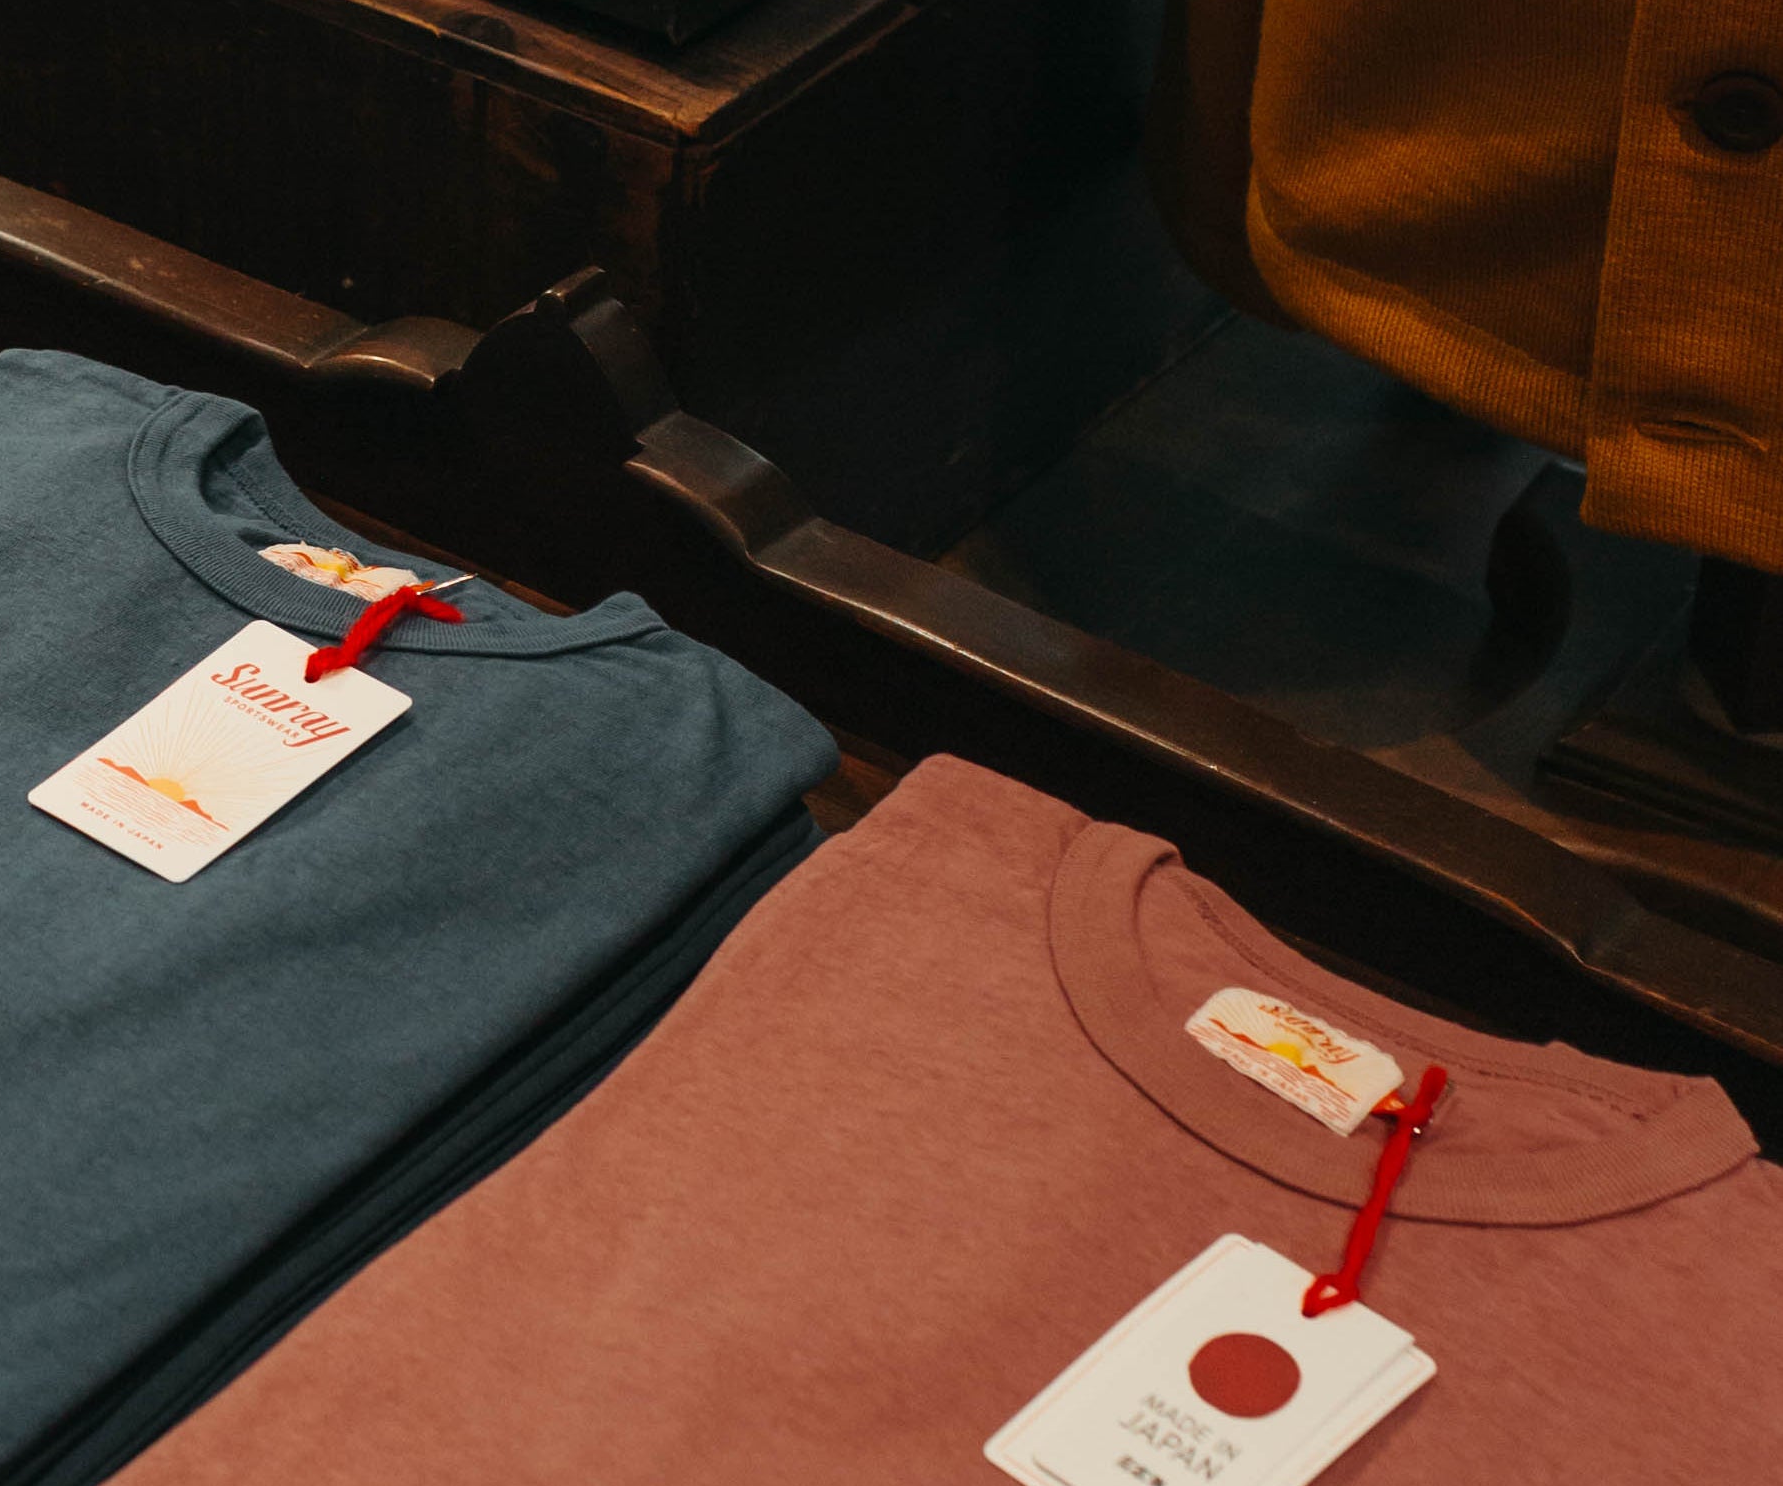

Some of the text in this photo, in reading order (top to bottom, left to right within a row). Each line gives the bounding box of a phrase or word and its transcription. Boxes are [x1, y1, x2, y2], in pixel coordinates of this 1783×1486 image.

[210, 662, 352, 748] Sunray
[223, 695, 302, 740] SPORTSWEAR
[1117, 1412, 1225, 1481] JAPAN
[1142, 1394, 1213, 1442] MADE
